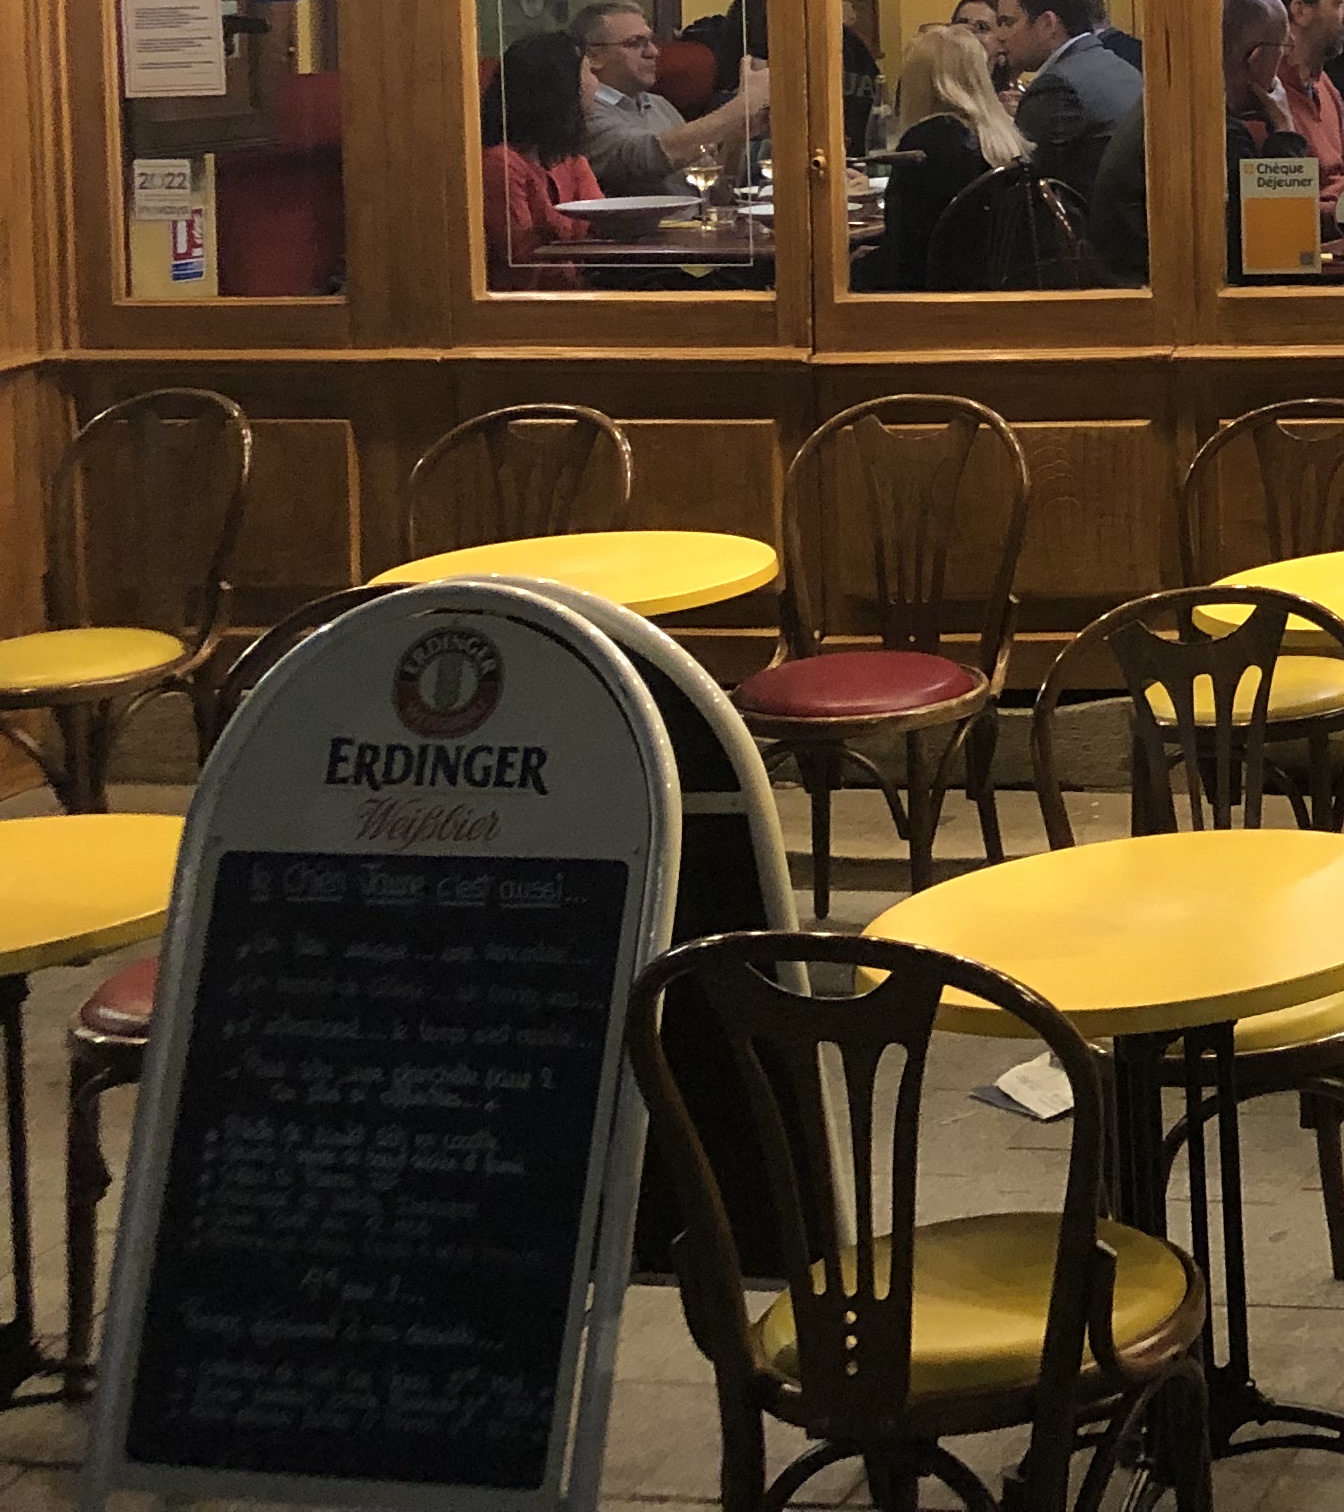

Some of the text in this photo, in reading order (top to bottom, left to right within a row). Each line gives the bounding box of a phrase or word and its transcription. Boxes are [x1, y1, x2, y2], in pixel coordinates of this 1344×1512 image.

[1256, 163, 1305, 177] Chèque
[1257, 176, 1313, 190] Déjeuner
[324, 737, 549, 795] ERDINGER
[354, 798, 502, 846] Weißbier
